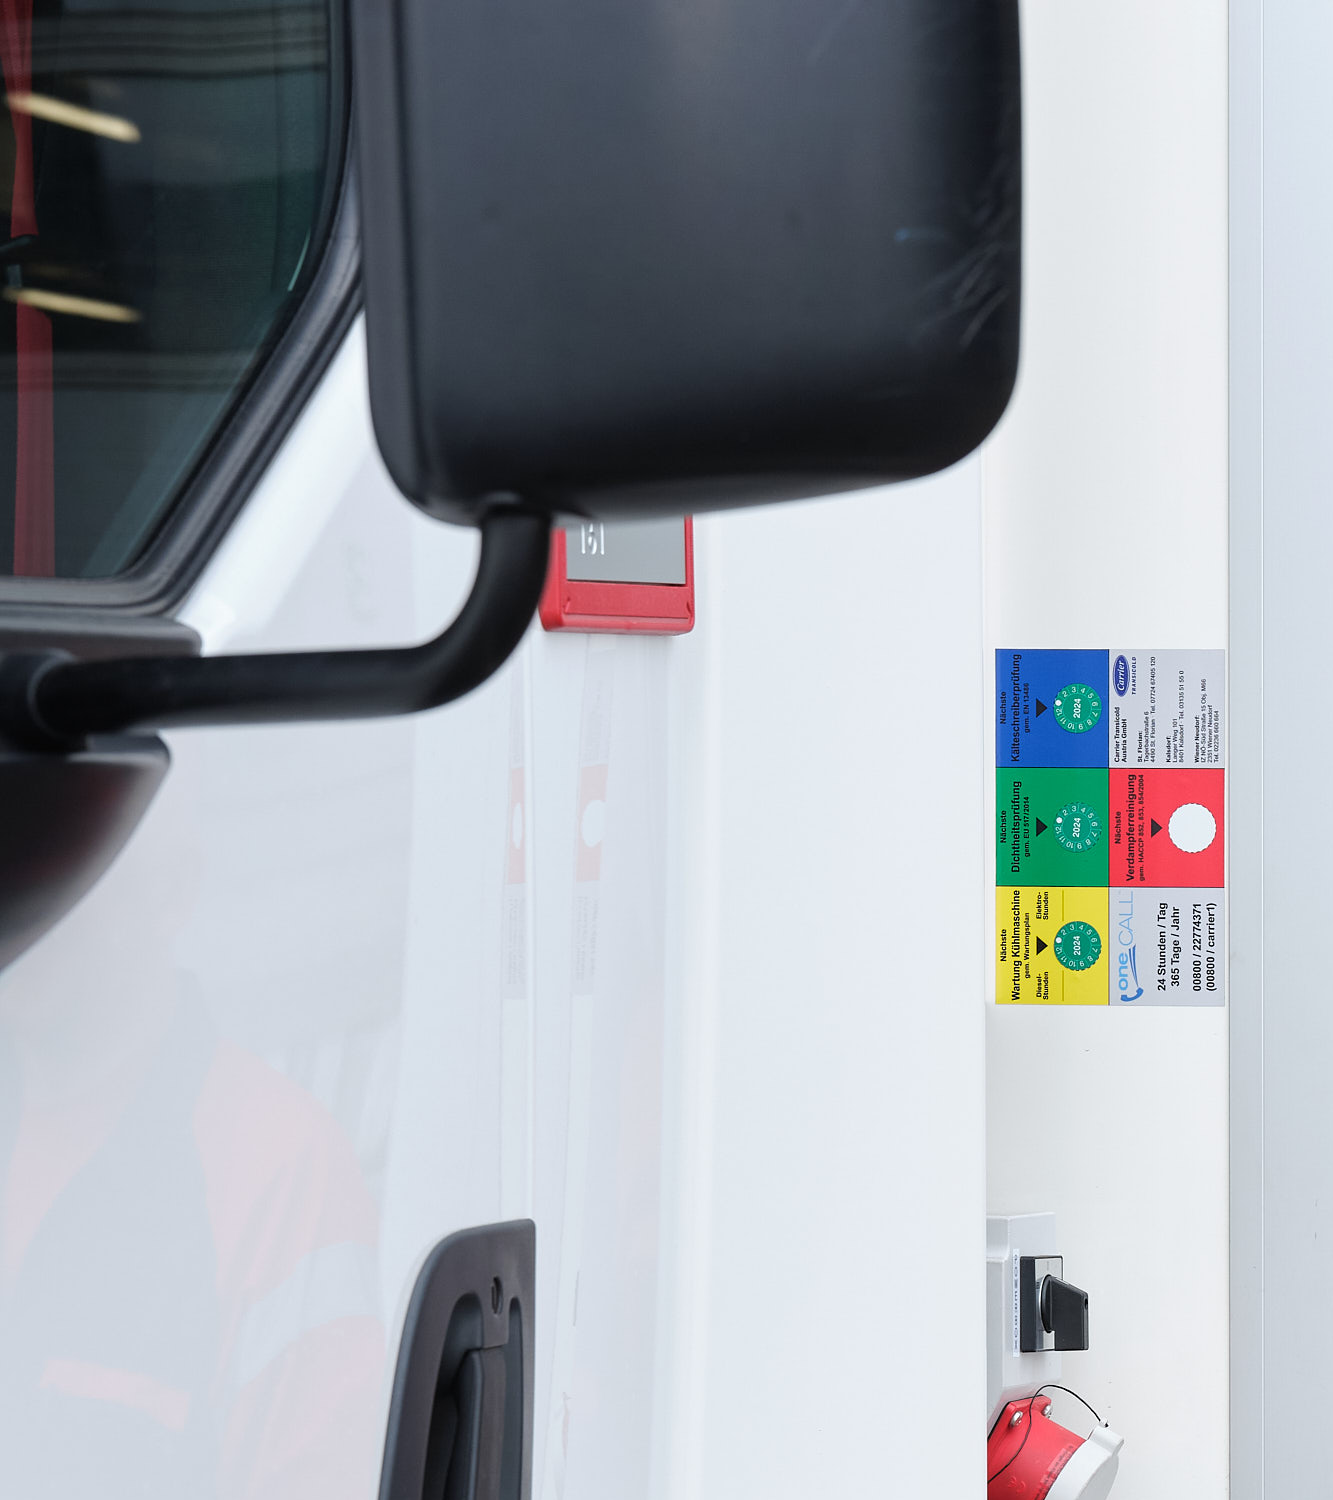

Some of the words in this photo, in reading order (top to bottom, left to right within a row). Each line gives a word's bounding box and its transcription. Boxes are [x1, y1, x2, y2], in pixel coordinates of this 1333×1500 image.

[1117, 660, 1125, 690] Carrier
[1011, 654, 1021, 761] Kälteschreiberprüfung
[1024, 705, 1029, 714] EN
[1073, 699, 1081, 718] 2024
[1011, 781, 1021, 872] Dichtheitsprüfung
[1024, 829, 1029, 838] EU
[1126, 775, 1136, 881] Verdampferreinigung
[1011, 890, 1020, 957] Kühlmaschine
[1118, 891, 1133, 946] CALL
[1158, 903, 1168, 921] Tag
[1171, 907, 1179, 930] Jahr
[1193, 904, 1201, 951] 22774371
[1206, 903, 1217, 947] carrier1)
[1158, 931, 1166, 975] Stunden
[1171, 940, 1181, 965] Tage
[1012, 960, 1022, 1000] Wartung
[1118, 953, 1128, 990] one
[1158, 979, 1166, 991] 24
[1171, 968, 1179, 986] 365
[1193, 960, 1201, 991] 00800
[1207, 957, 1217, 991] (00800
